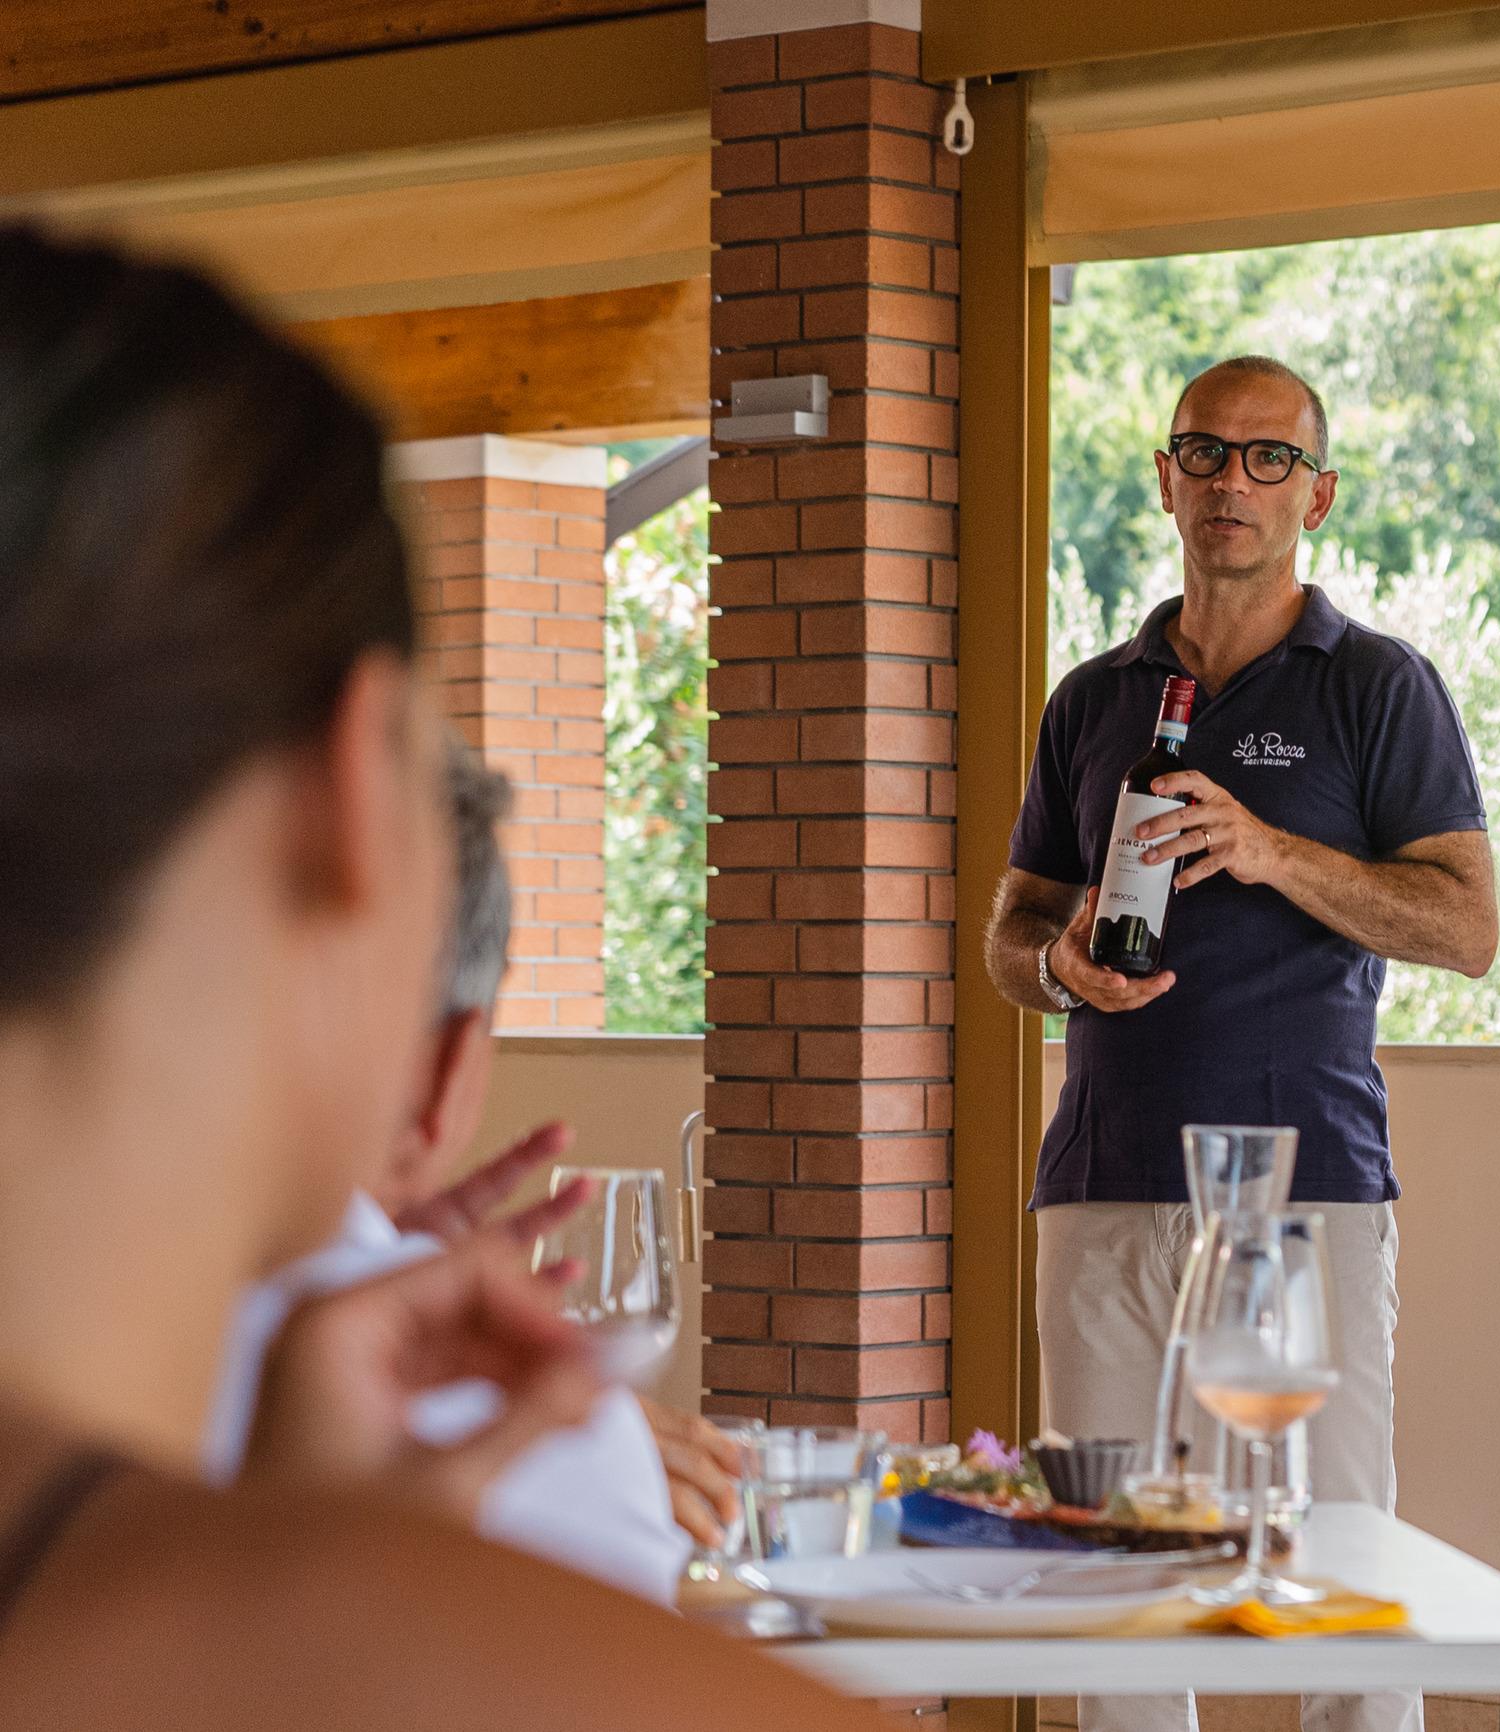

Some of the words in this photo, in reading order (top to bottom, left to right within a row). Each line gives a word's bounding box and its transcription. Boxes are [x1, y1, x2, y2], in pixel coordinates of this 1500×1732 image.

[1232, 733, 1258, 758] La
[1261, 732, 1306, 758] Rocca
[1242, 758, 1291, 767] AGRITURISMO
